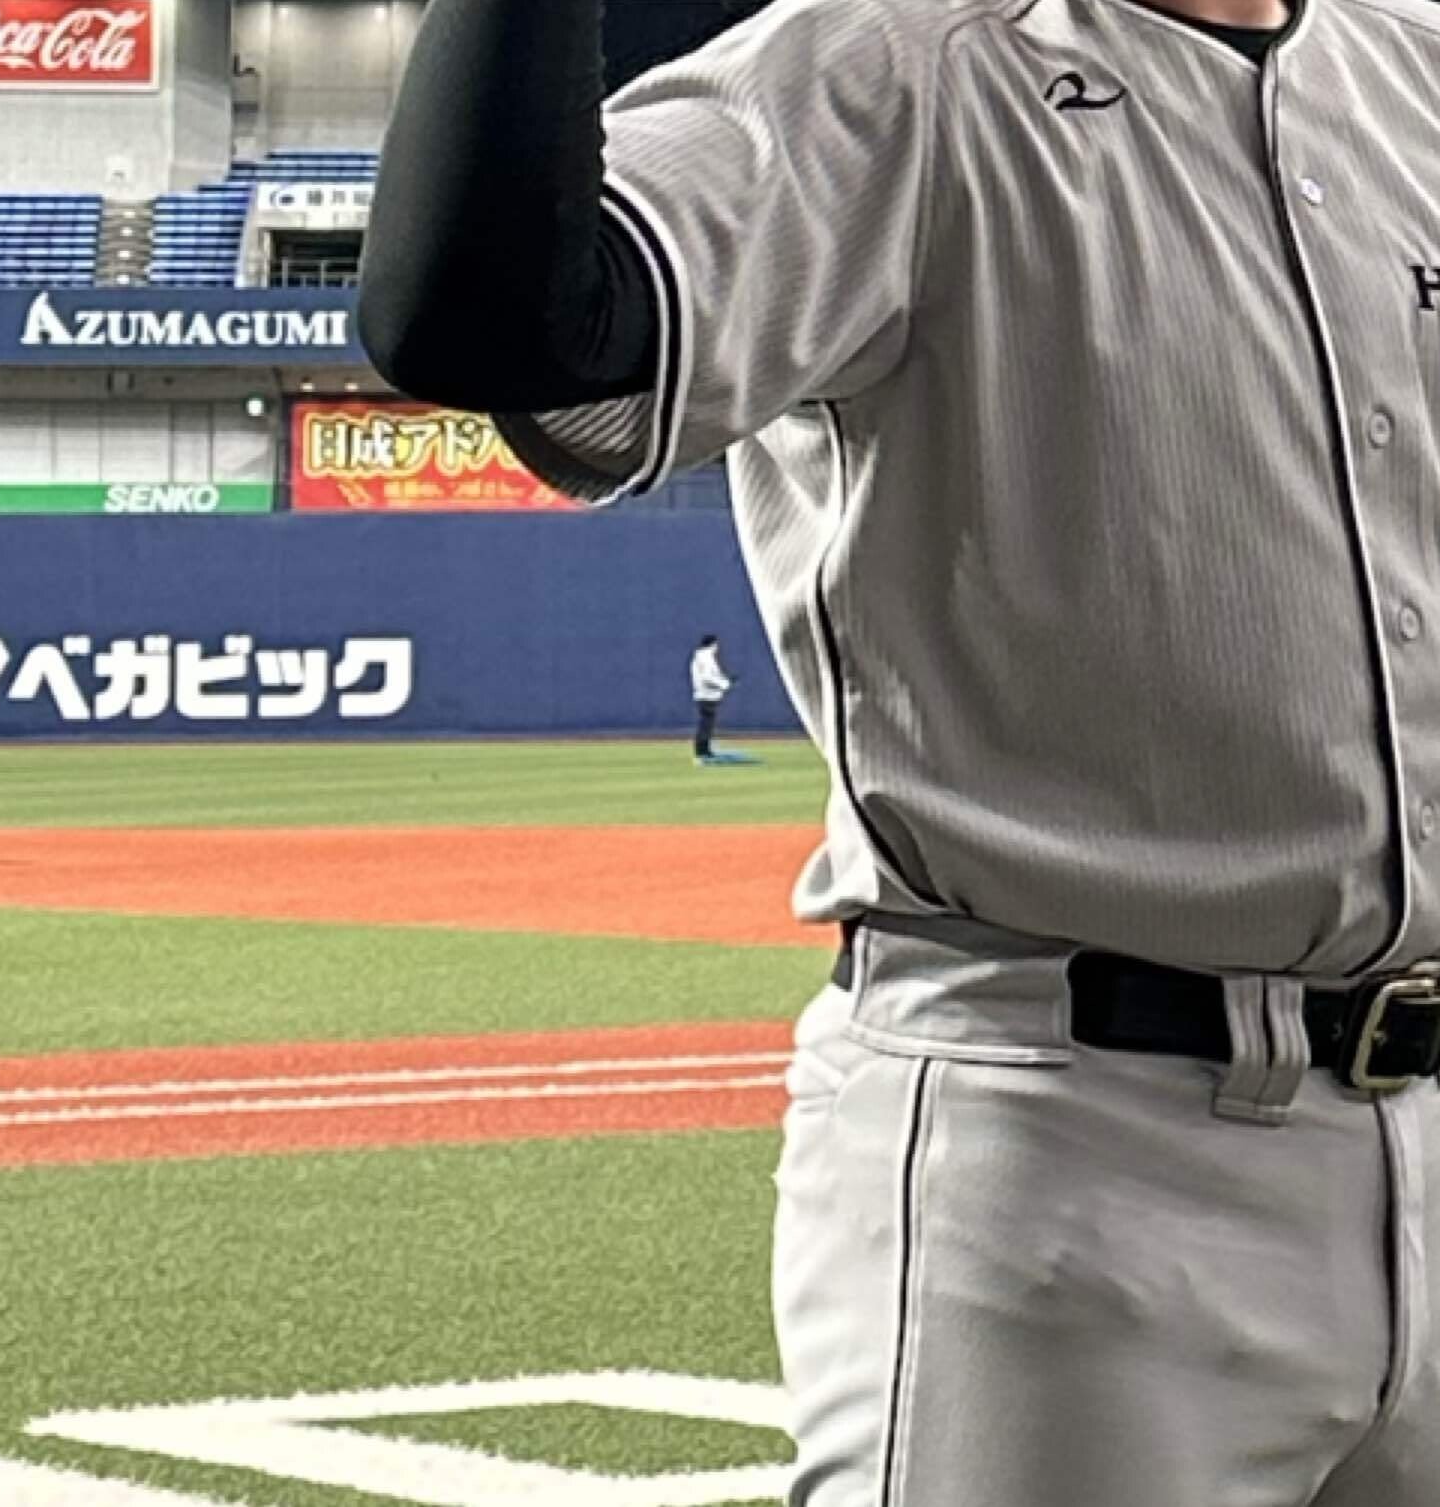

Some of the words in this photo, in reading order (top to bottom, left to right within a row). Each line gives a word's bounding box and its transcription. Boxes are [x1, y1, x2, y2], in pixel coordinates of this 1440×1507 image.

[20, 292, 347, 346] AZUMAGUMI
[103, 483, 220, 513] SENKO
[8, 636, 412, 720] ベガビック
